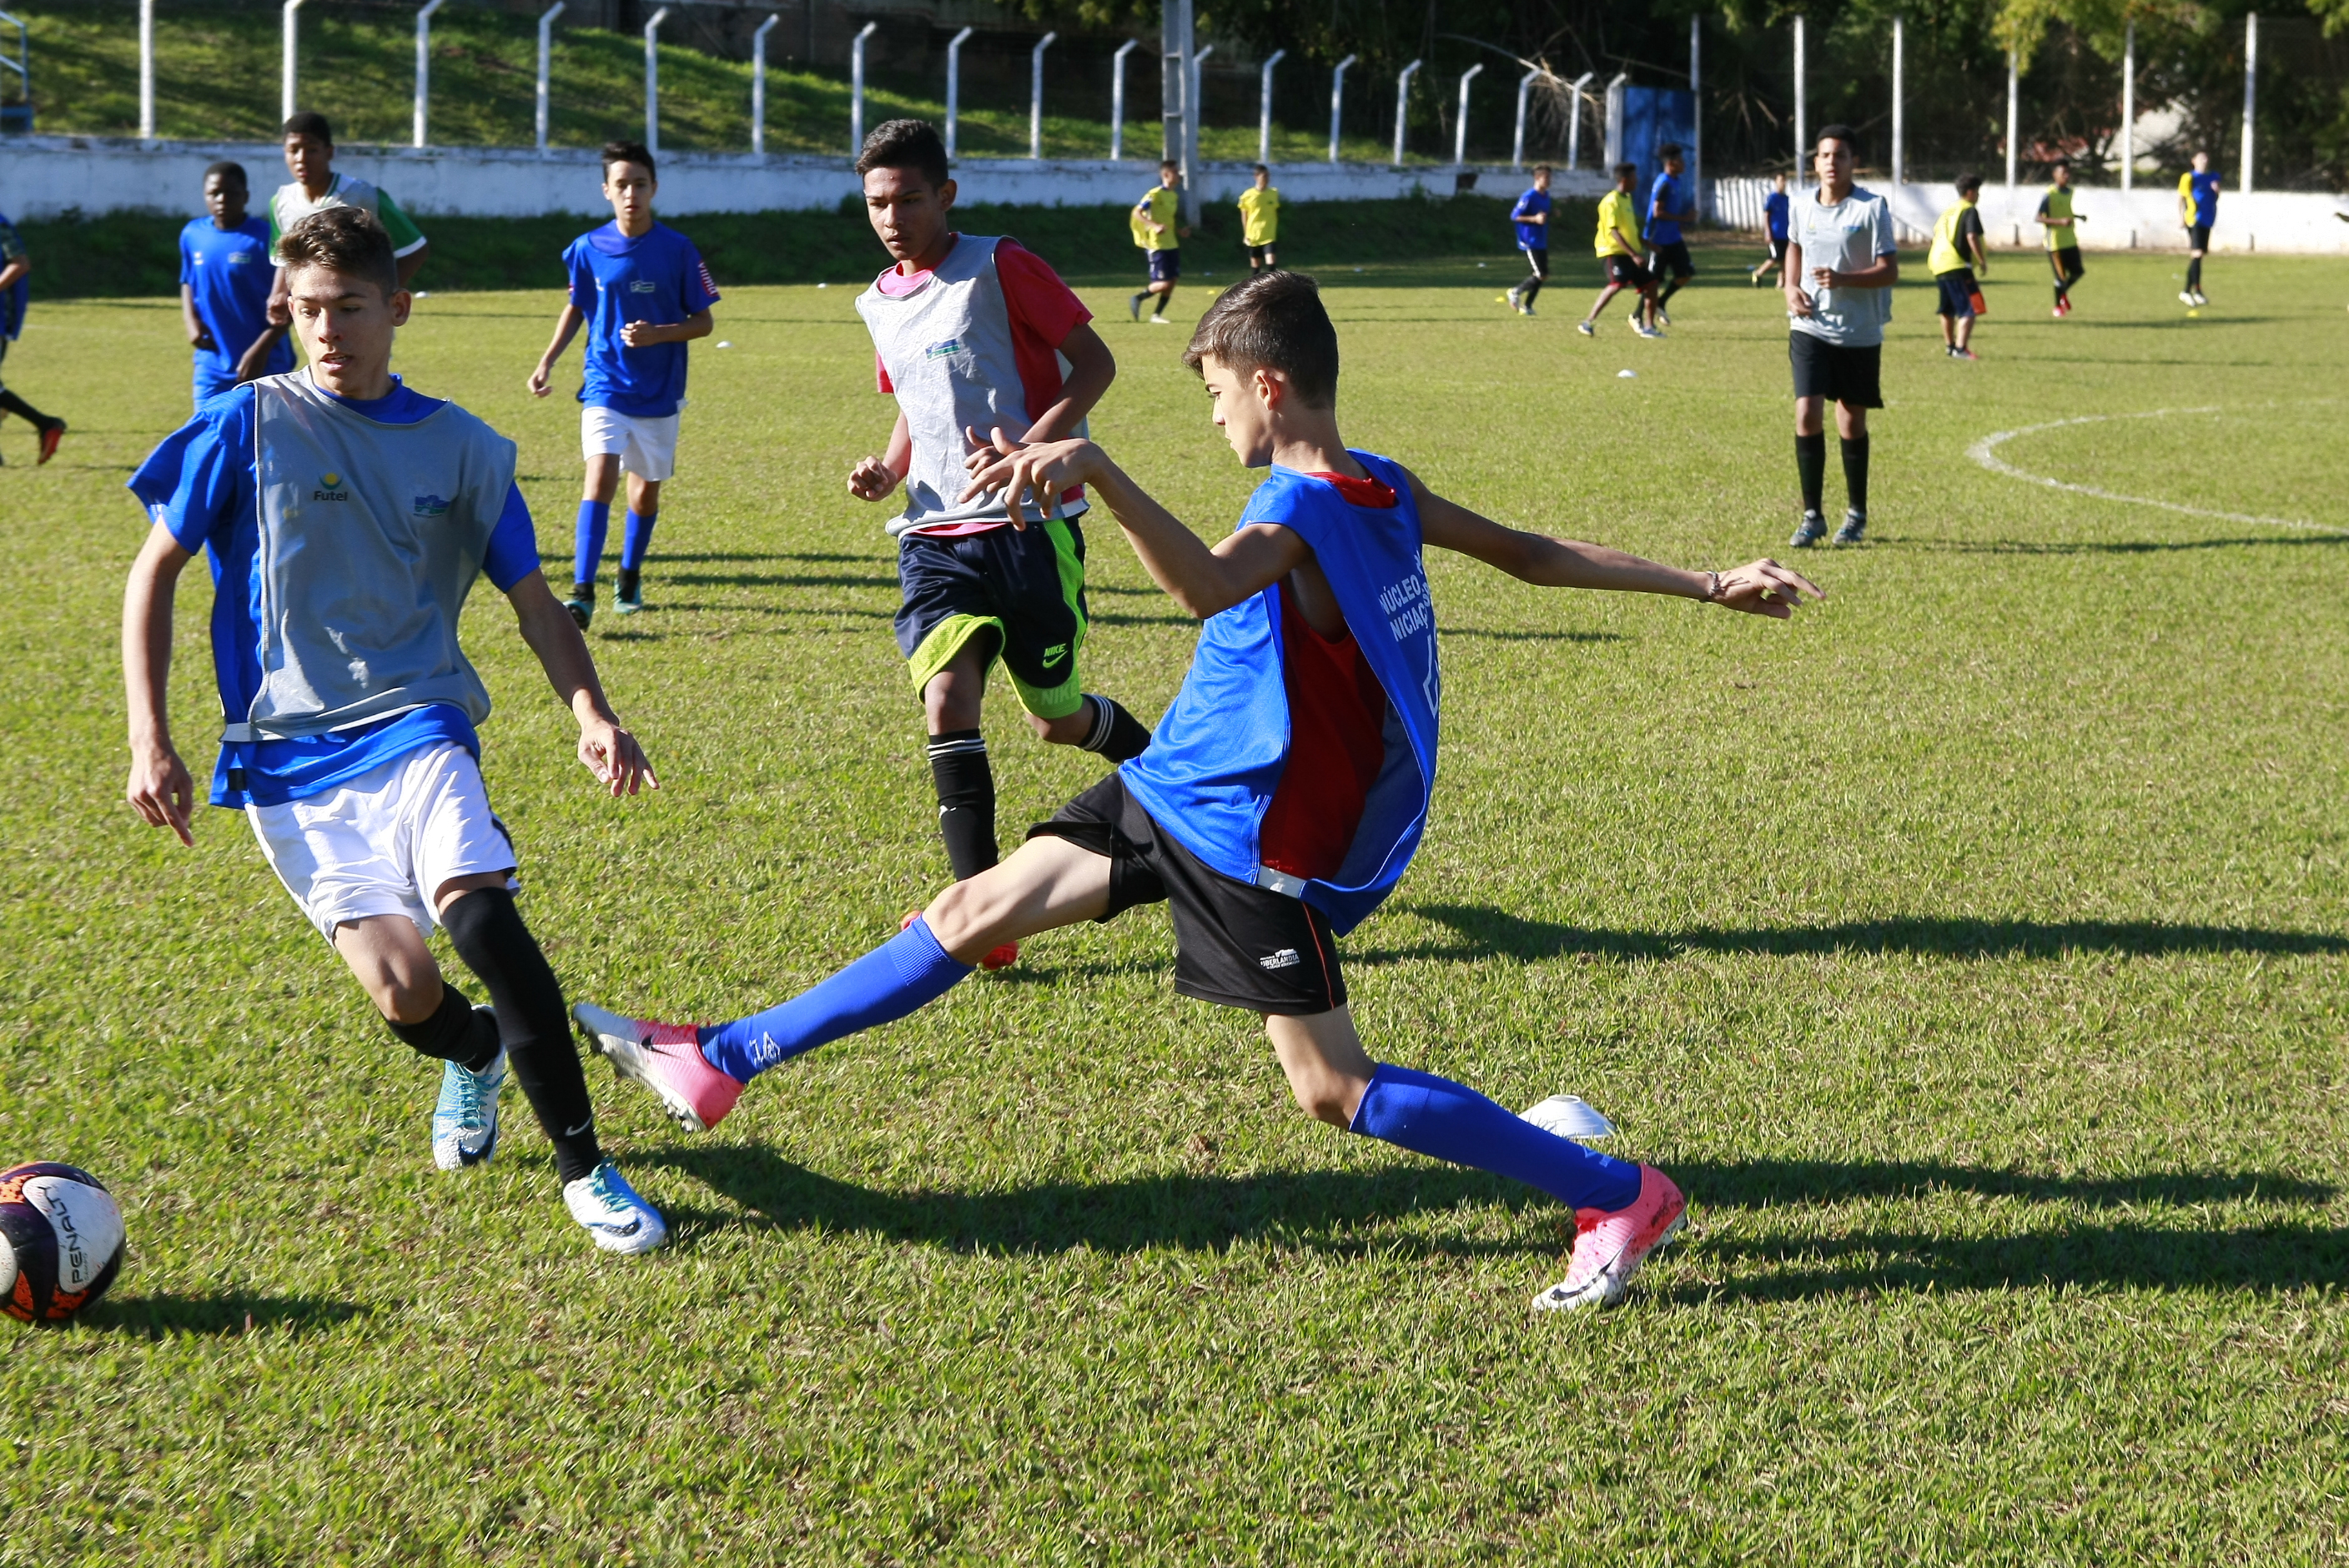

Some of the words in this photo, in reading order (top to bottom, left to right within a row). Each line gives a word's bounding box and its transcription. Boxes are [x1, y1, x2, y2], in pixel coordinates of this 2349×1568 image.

[314, 490, 348, 501] Futel
[1378, 574, 1421, 615] NÚCLEO
[1390, 601, 1428, 642] NICIAÇ
[1044, 643, 1066, 657] NIKE
[38, 1185, 83, 1284] PENALTY
